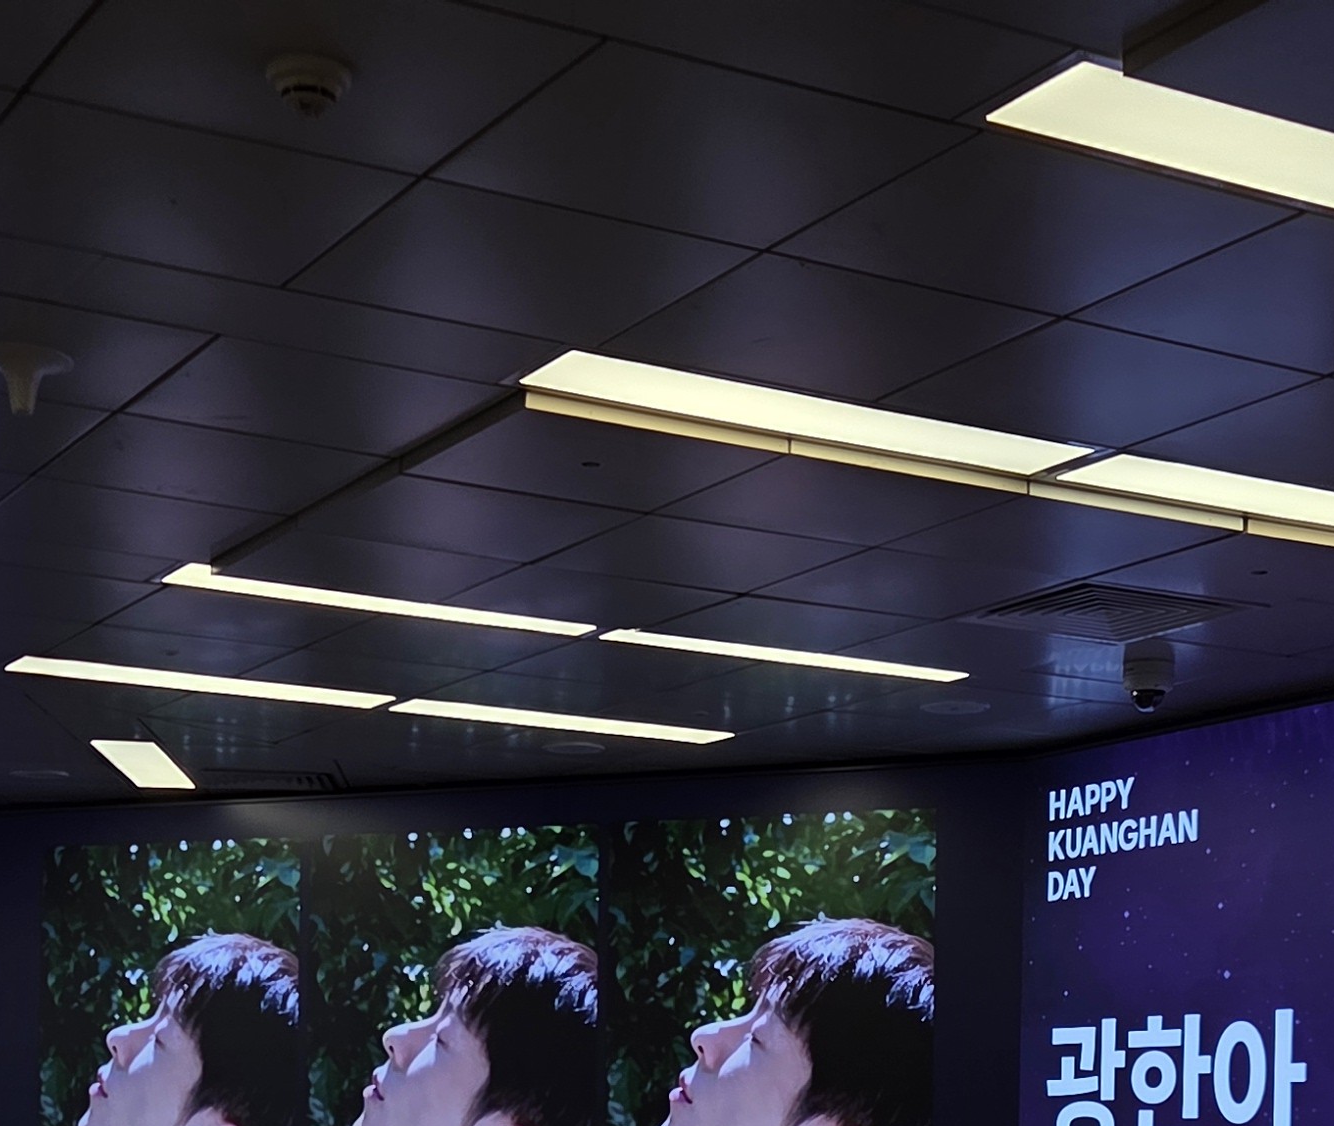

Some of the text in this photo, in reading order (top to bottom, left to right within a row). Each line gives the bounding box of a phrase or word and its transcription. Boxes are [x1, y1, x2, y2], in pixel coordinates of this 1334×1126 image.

[1048, 776, 1135, 822] HAPPY
[1047, 808, 1200, 862] KUANGHAN
[1047, 865, 1097, 902] DAY
